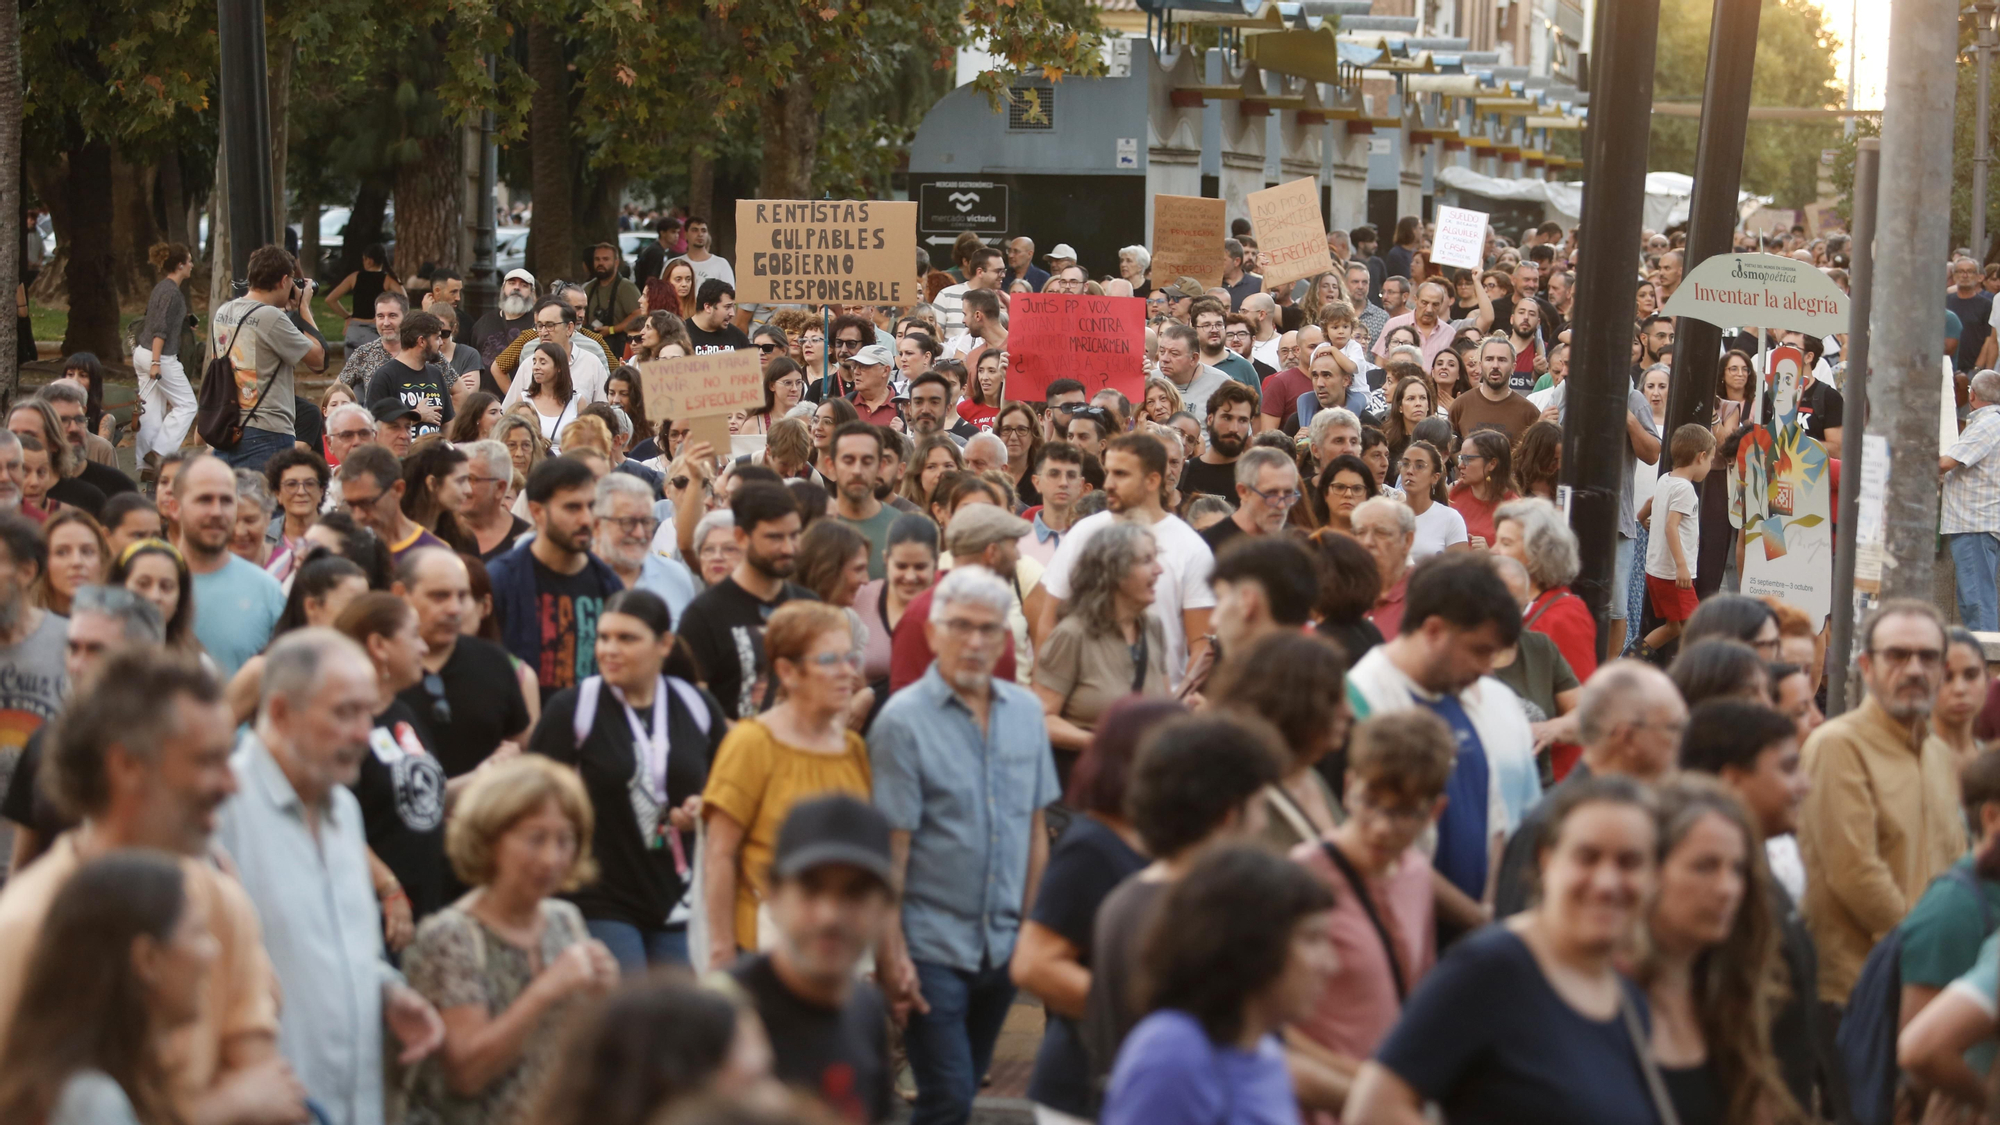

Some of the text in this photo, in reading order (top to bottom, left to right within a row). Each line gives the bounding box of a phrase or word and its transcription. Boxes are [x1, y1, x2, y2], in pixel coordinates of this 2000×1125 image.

[756, 201, 869, 223] RENTISTAS
[1257, 193, 1307, 216] NO PIDO
[931, 214, 997, 223] mercado victoria
[1449, 211, 1479, 223] SUELDO
[771, 228, 885, 249] CULPABLES
[1442, 225, 1479, 239] ALQUILER
[1443, 241, 1466, 253] CASA
[753, 251, 854, 276] GOBIERNO
[1168, 264, 1213, 275] DERECHO
[1731, 269, 1796, 284] cosmopoética
[769, 279, 900, 301] RESPONSABLE
[1065, 299, 1079, 314] PP
[1088, 300, 1112, 314] VOX
[1694, 282, 1838, 317] Inventar la alegría
[1020, 316, 1124, 333] VOTAN EN CONTRA
[1069, 336, 1130, 354] MARICARMEN
[648, 356, 750, 376] VIVIENDA PARA
[1051, 355, 1081, 373] VAIS
[1084, 356, 1094, 371] A
[703, 375, 721, 388] NO
[730, 373, 759, 385] PARA
[685, 388, 759, 411] ESPECULAR
[1749, 586, 1771, 595] Córdoba
[1794, 584, 1814, 592] octubre
